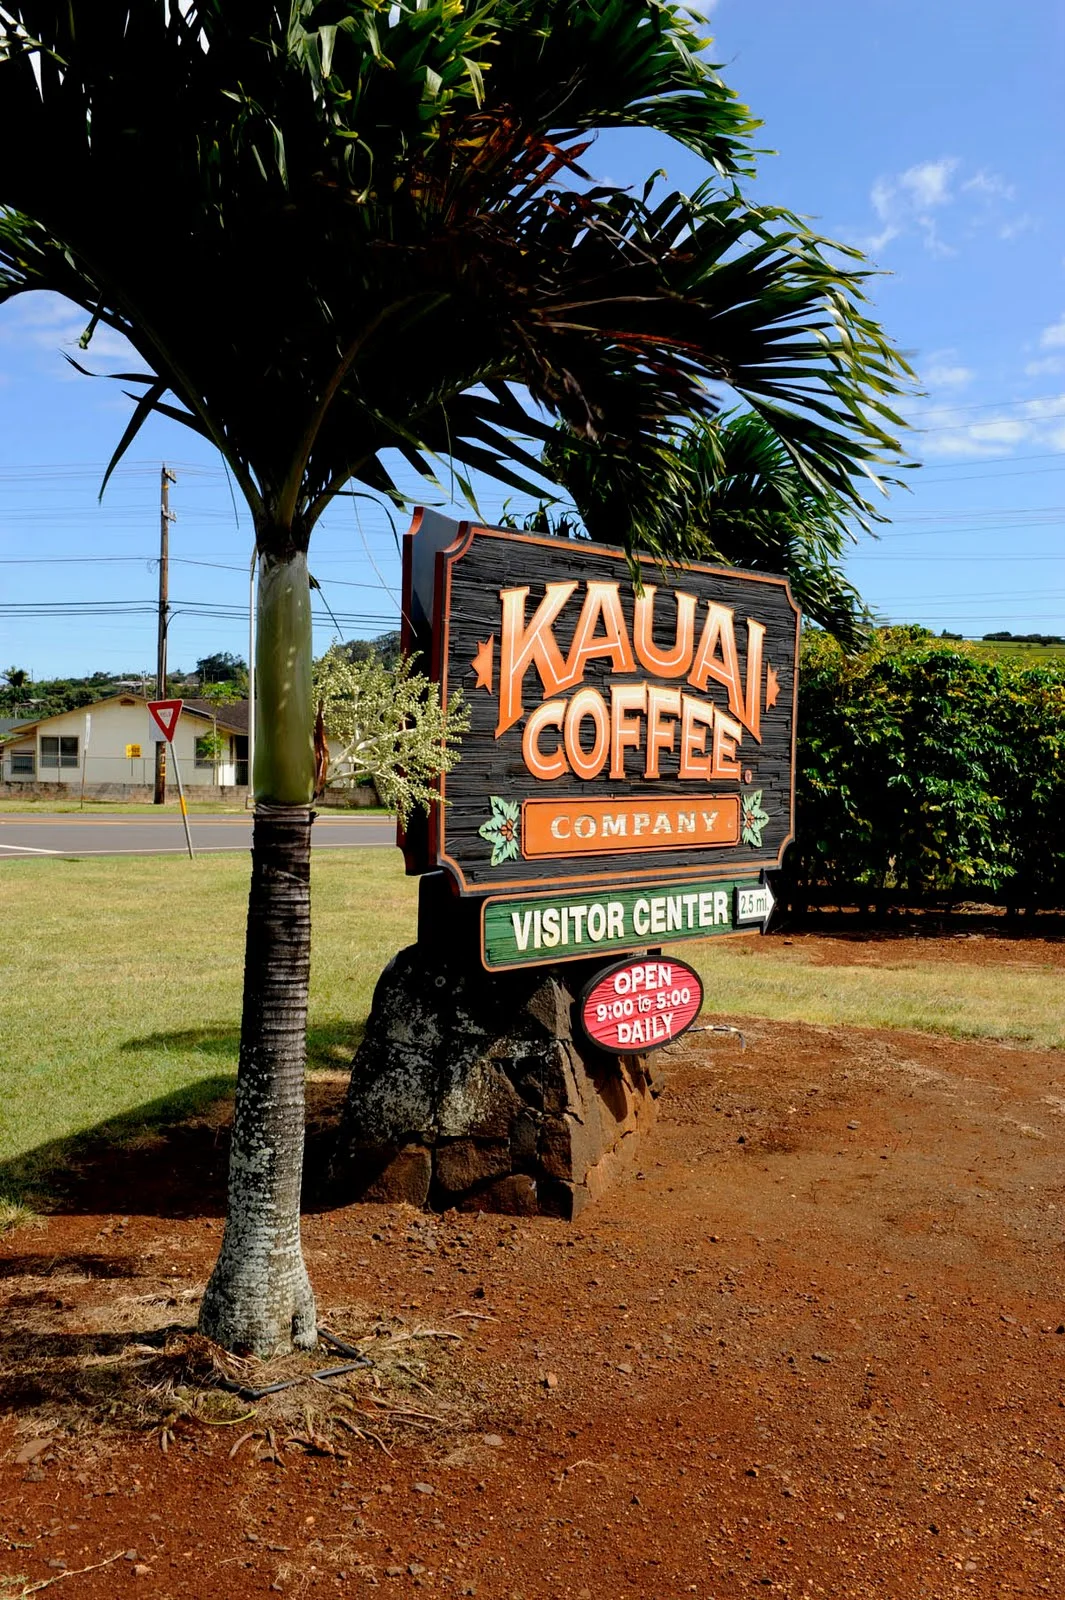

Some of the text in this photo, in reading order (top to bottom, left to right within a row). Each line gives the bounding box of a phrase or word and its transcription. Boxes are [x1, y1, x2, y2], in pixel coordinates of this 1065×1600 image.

[495, 581, 767, 743] KAUAI
[523, 681, 742, 780] COFFEE
[551, 812, 718, 839] COMPANY
[740, 895, 753, 914] 2.5
[512, 891, 728, 950] VISITOR CENTER
[614, 965, 673, 994] OPEN
[597, 989, 690, 1021] 9:00 to 5:00
[617, 1014, 674, 1044] DAILY
